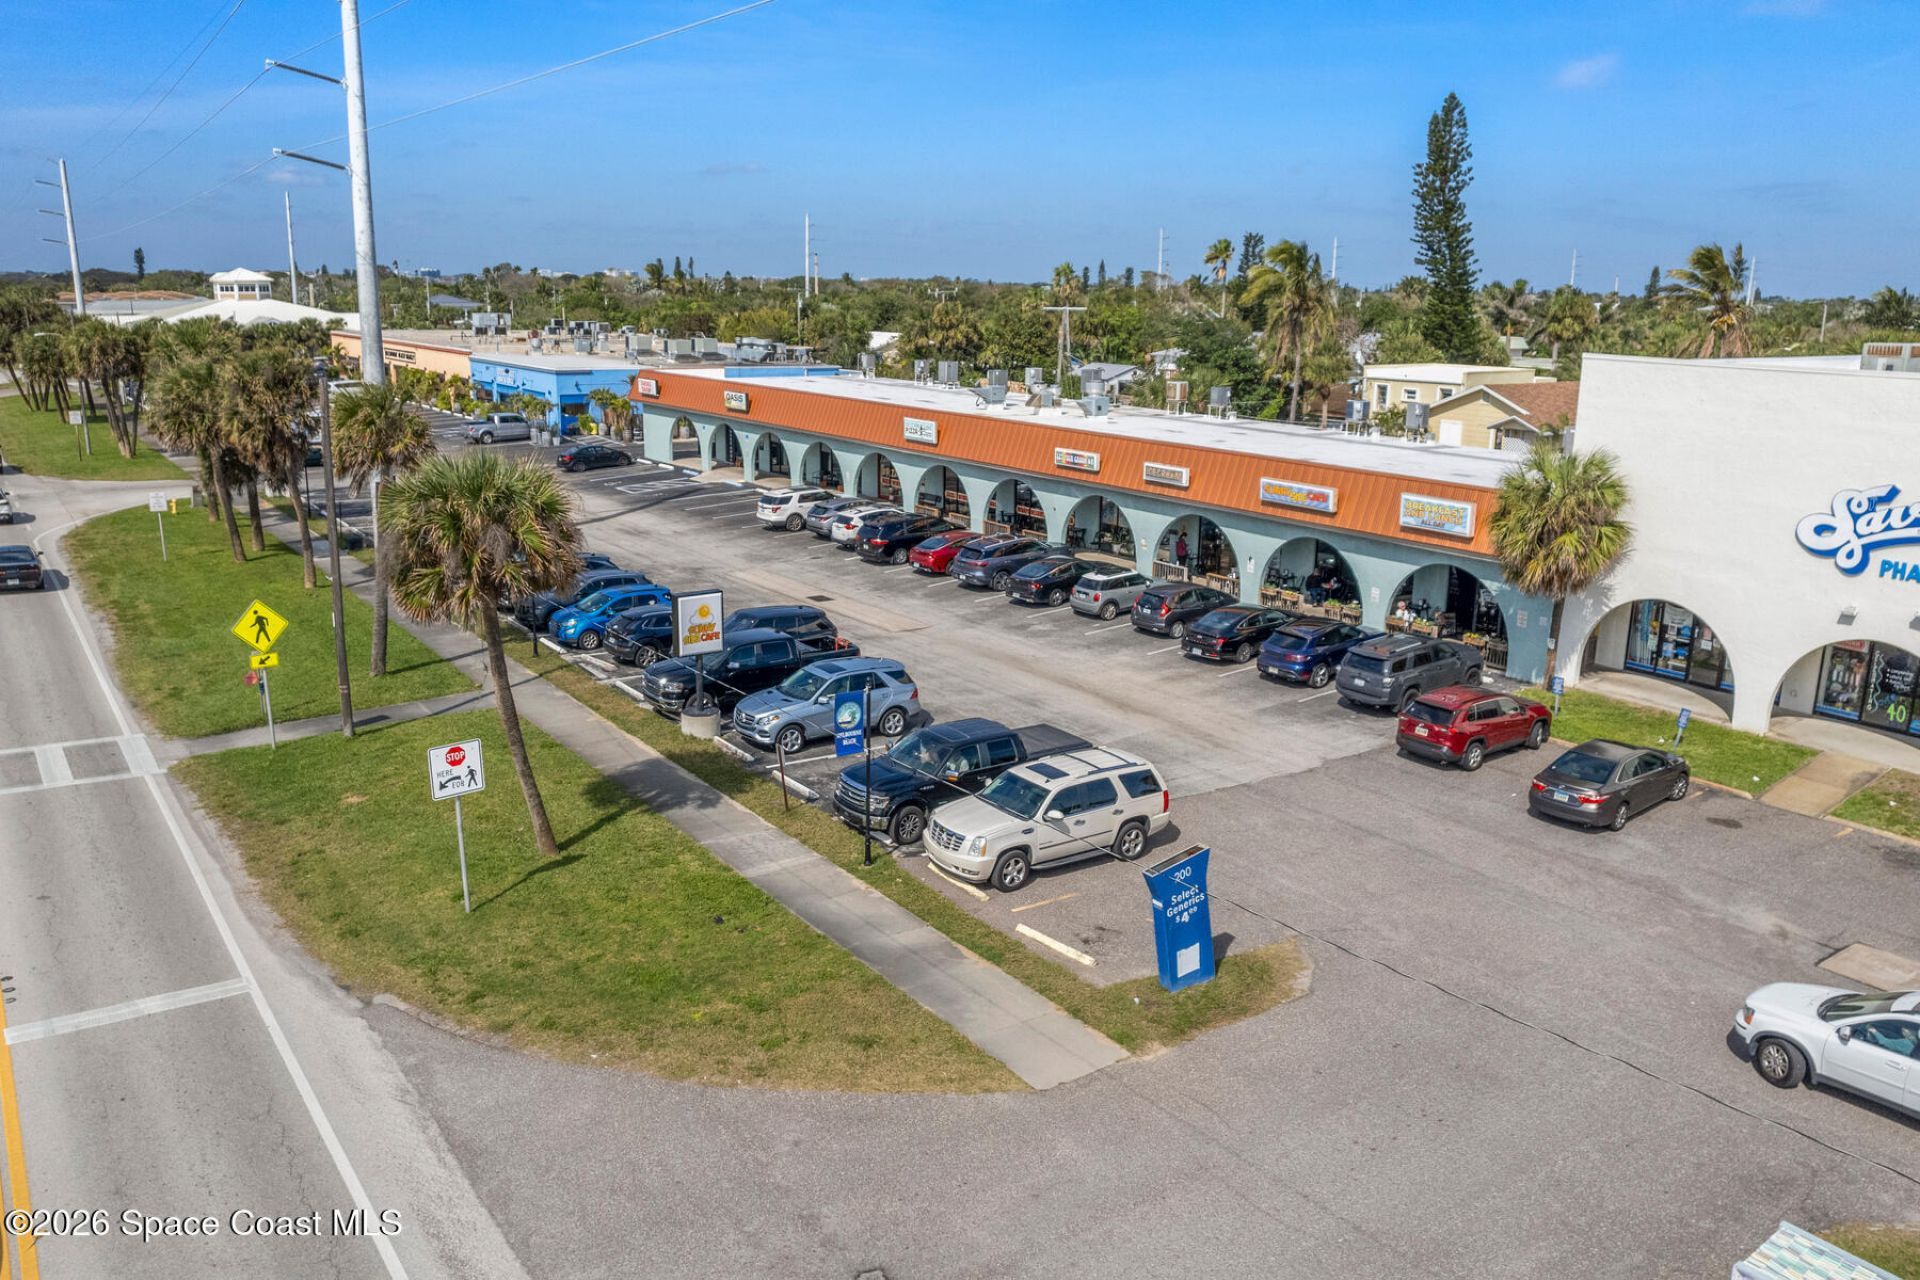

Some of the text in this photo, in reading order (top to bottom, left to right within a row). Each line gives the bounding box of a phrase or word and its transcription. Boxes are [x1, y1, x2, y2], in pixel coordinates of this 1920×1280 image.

[725, 393, 744, 402] OASIS
[1887, 703, 1907, 723] 40
[446, 751, 465, 762] STOP
[437, 768, 454, 778] HERE
[452, 780, 465, 789] FOR
[1174, 866, 1192, 883] 200
[1171, 884, 1199, 906] Select
[1166, 893, 1205, 918] Generics
